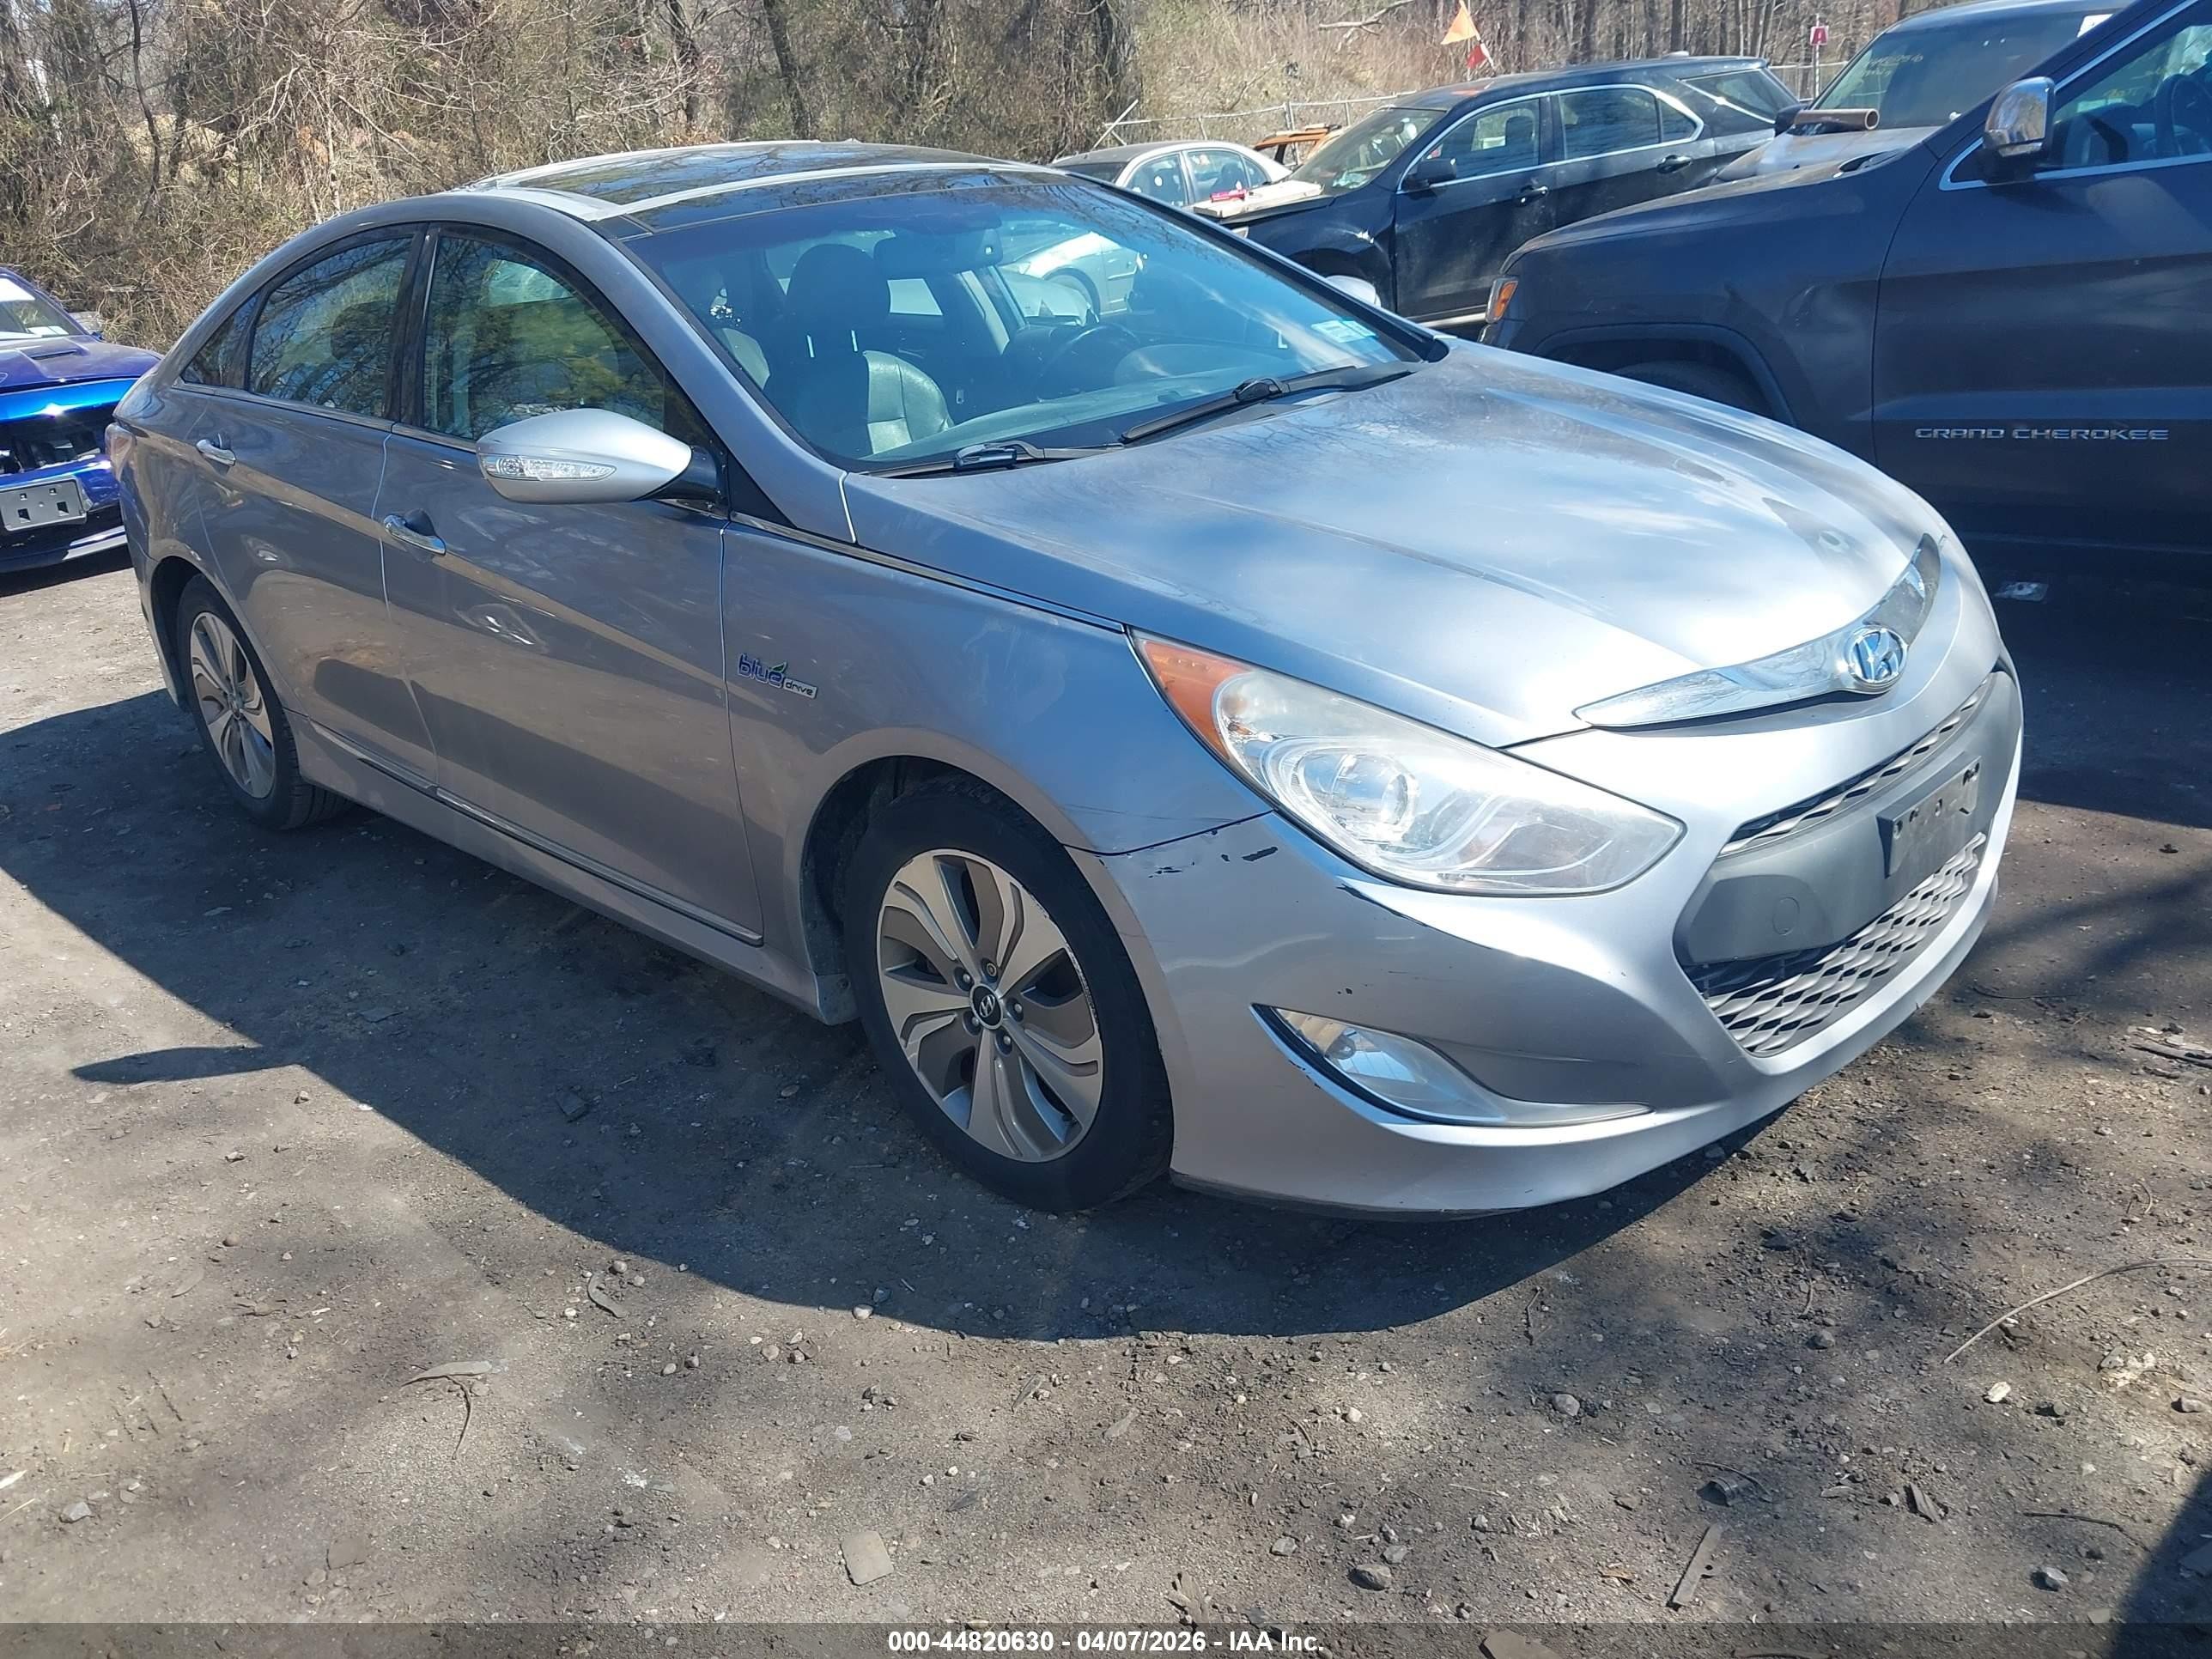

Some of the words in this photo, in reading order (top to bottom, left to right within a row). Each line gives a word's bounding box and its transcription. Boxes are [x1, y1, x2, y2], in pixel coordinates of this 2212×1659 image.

[1915, 428, 2005, 440] GRAND
[2012, 428, 2169, 441] CHEROKEE
[738, 653, 785, 688] blue
[785, 679, 814, 696] drive
